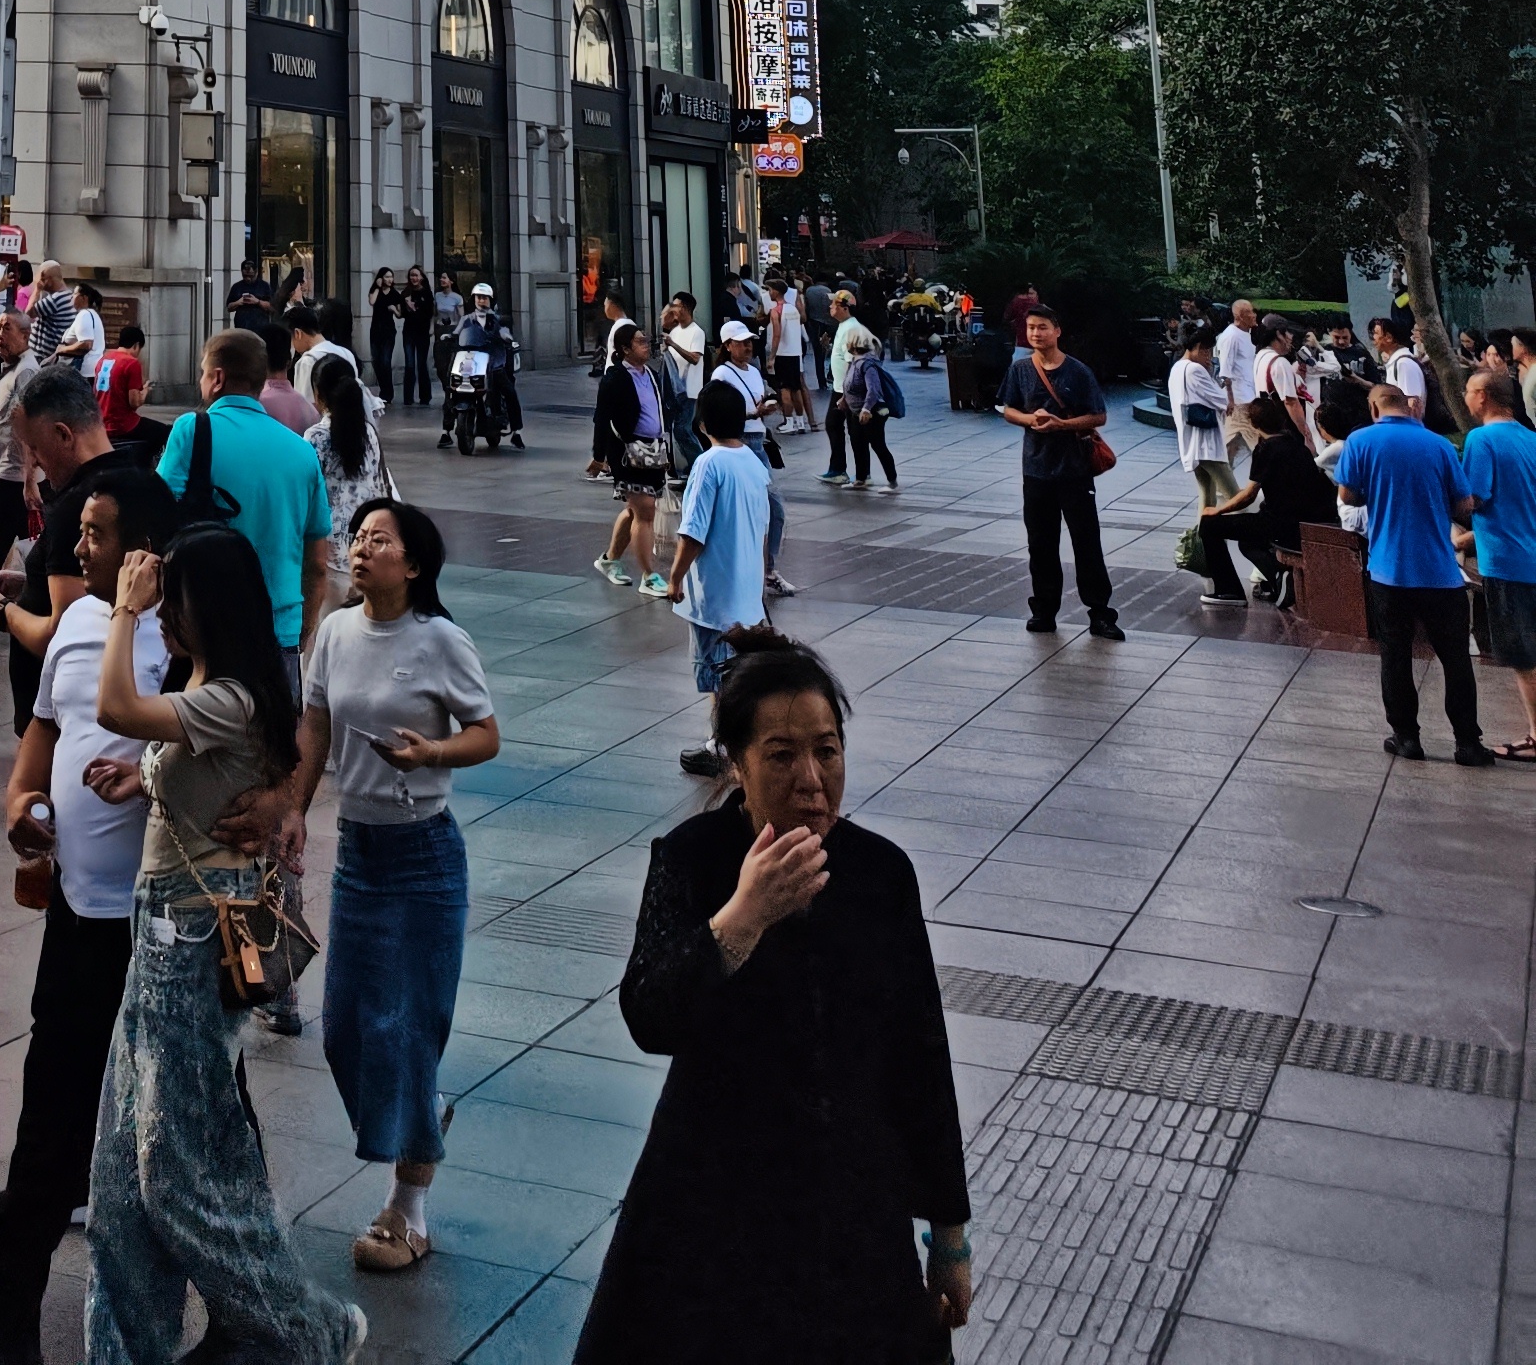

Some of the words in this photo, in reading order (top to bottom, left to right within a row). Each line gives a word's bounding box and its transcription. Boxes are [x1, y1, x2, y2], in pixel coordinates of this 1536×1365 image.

[271, 51, 318, 80] YOUNGOR
[449, 84, 483, 108] YOUNGOR
[755, 87, 782, 103] 寄存
[583, 107, 612, 128] YOUNGOR
